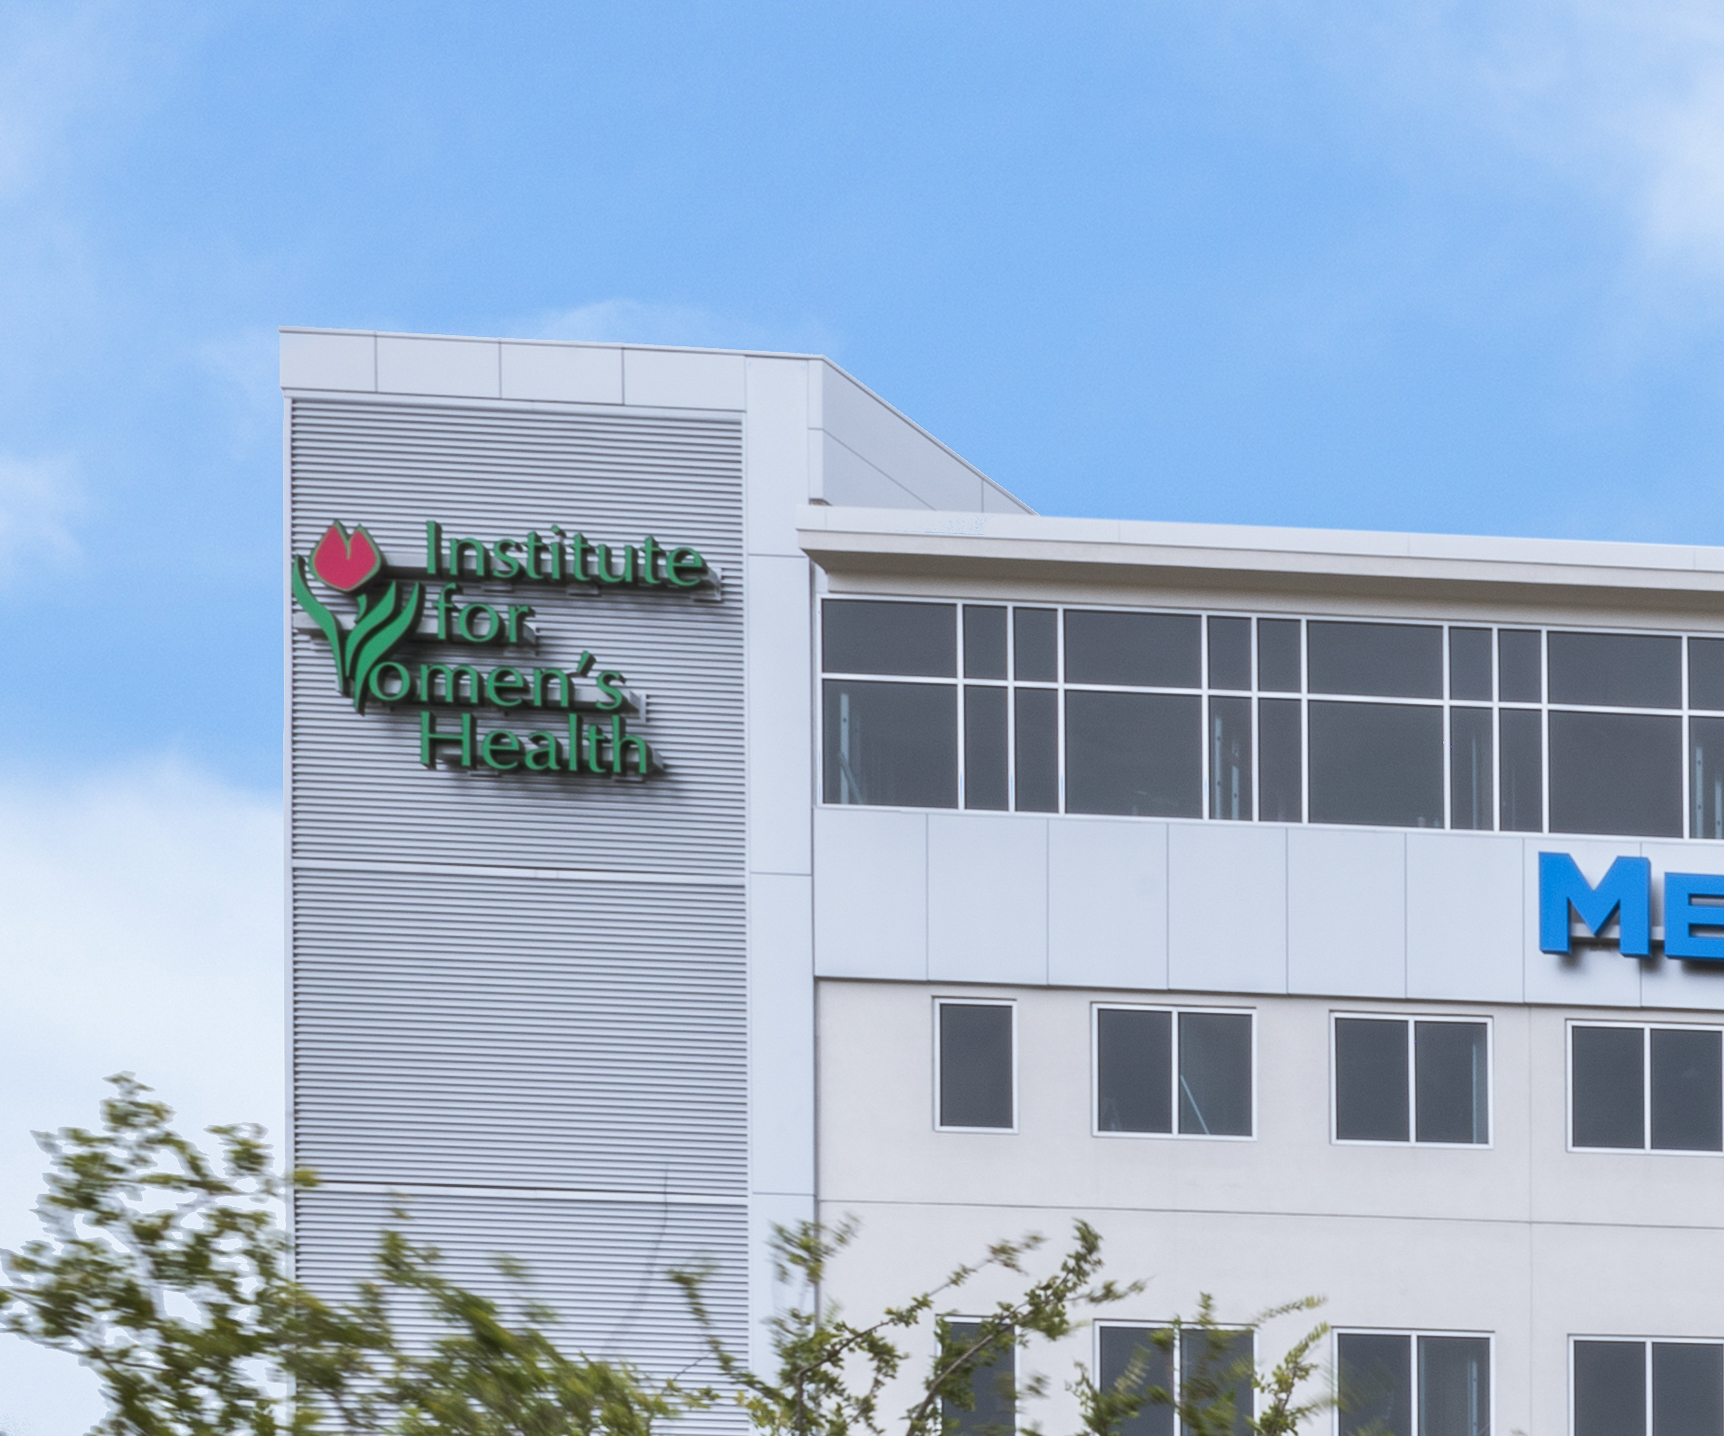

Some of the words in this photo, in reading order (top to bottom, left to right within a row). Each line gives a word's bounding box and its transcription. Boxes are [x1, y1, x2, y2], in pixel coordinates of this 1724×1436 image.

[426, 520, 703, 588] Institute
[433, 583, 534, 643] for
[419, 711, 649, 774] Health
